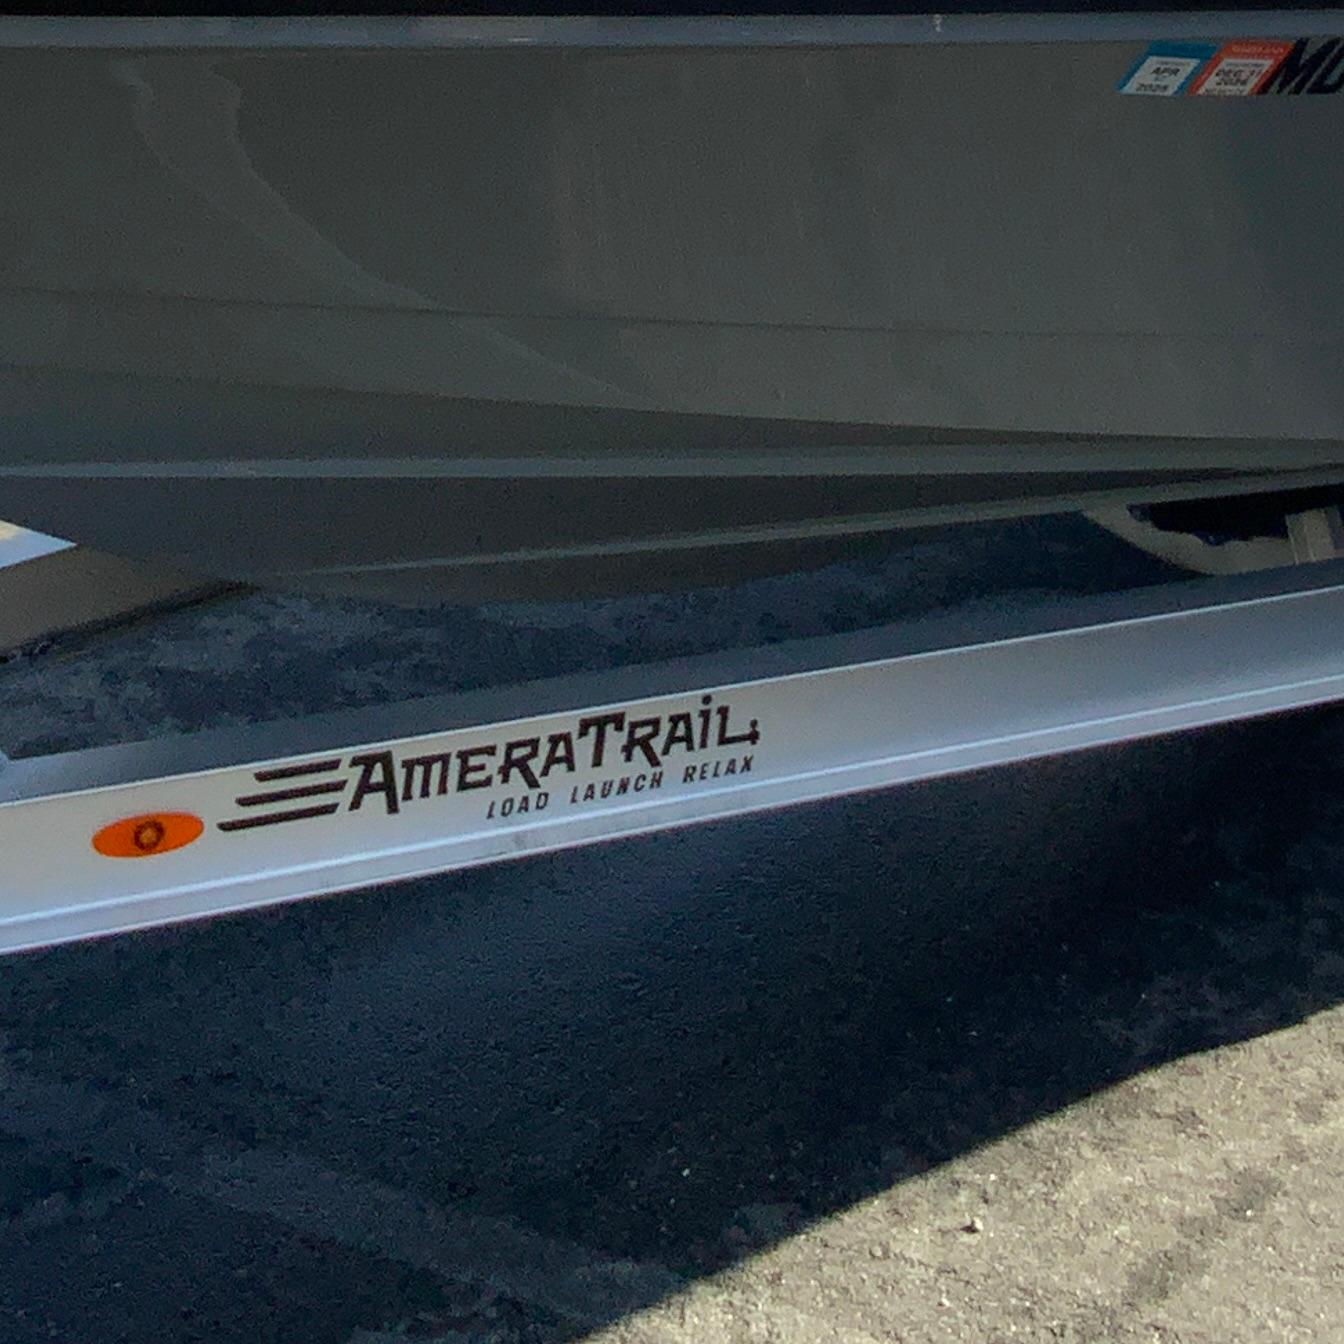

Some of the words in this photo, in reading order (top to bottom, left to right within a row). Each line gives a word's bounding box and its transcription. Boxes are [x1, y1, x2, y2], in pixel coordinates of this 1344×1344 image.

[486, 790, 550, 820] LOAD
[569, 769, 664, 805] LAUNCH
[682, 755, 755, 784] RELAX
